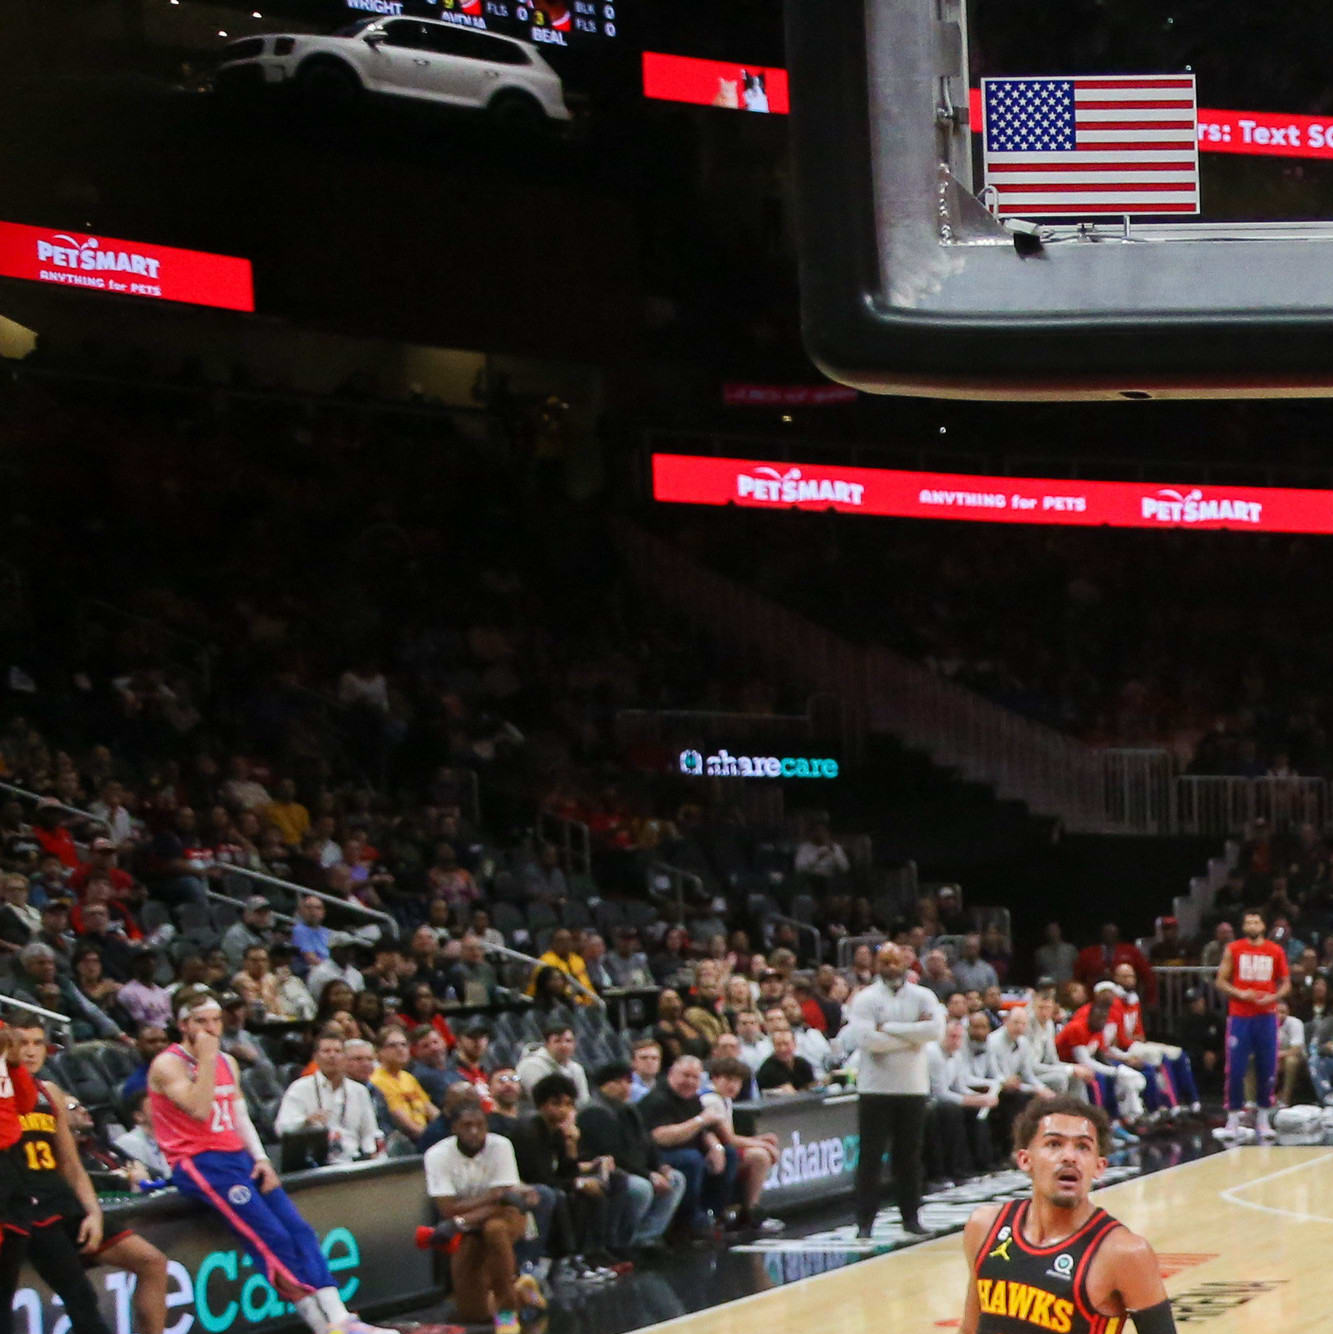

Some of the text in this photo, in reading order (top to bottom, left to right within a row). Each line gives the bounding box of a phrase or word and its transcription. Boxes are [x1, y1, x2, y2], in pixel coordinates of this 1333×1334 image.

[531, 27, 568, 46] BEAL
[1238, 119, 1301, 147] Text
[37, 234, 160, 279] PETSMART
[40, 269, 162, 297] ANYTHING for PETS
[737, 467, 865, 505] PETSMART
[919, 489, 1087, 512] ANYTHING for PETS
[1141, 489, 1263, 523] PETSMART
[211, 1100, 234, 1133] 24
[24, 1140, 57, 1171] 13
[977, 1278, 1075, 1334] HAWKS
